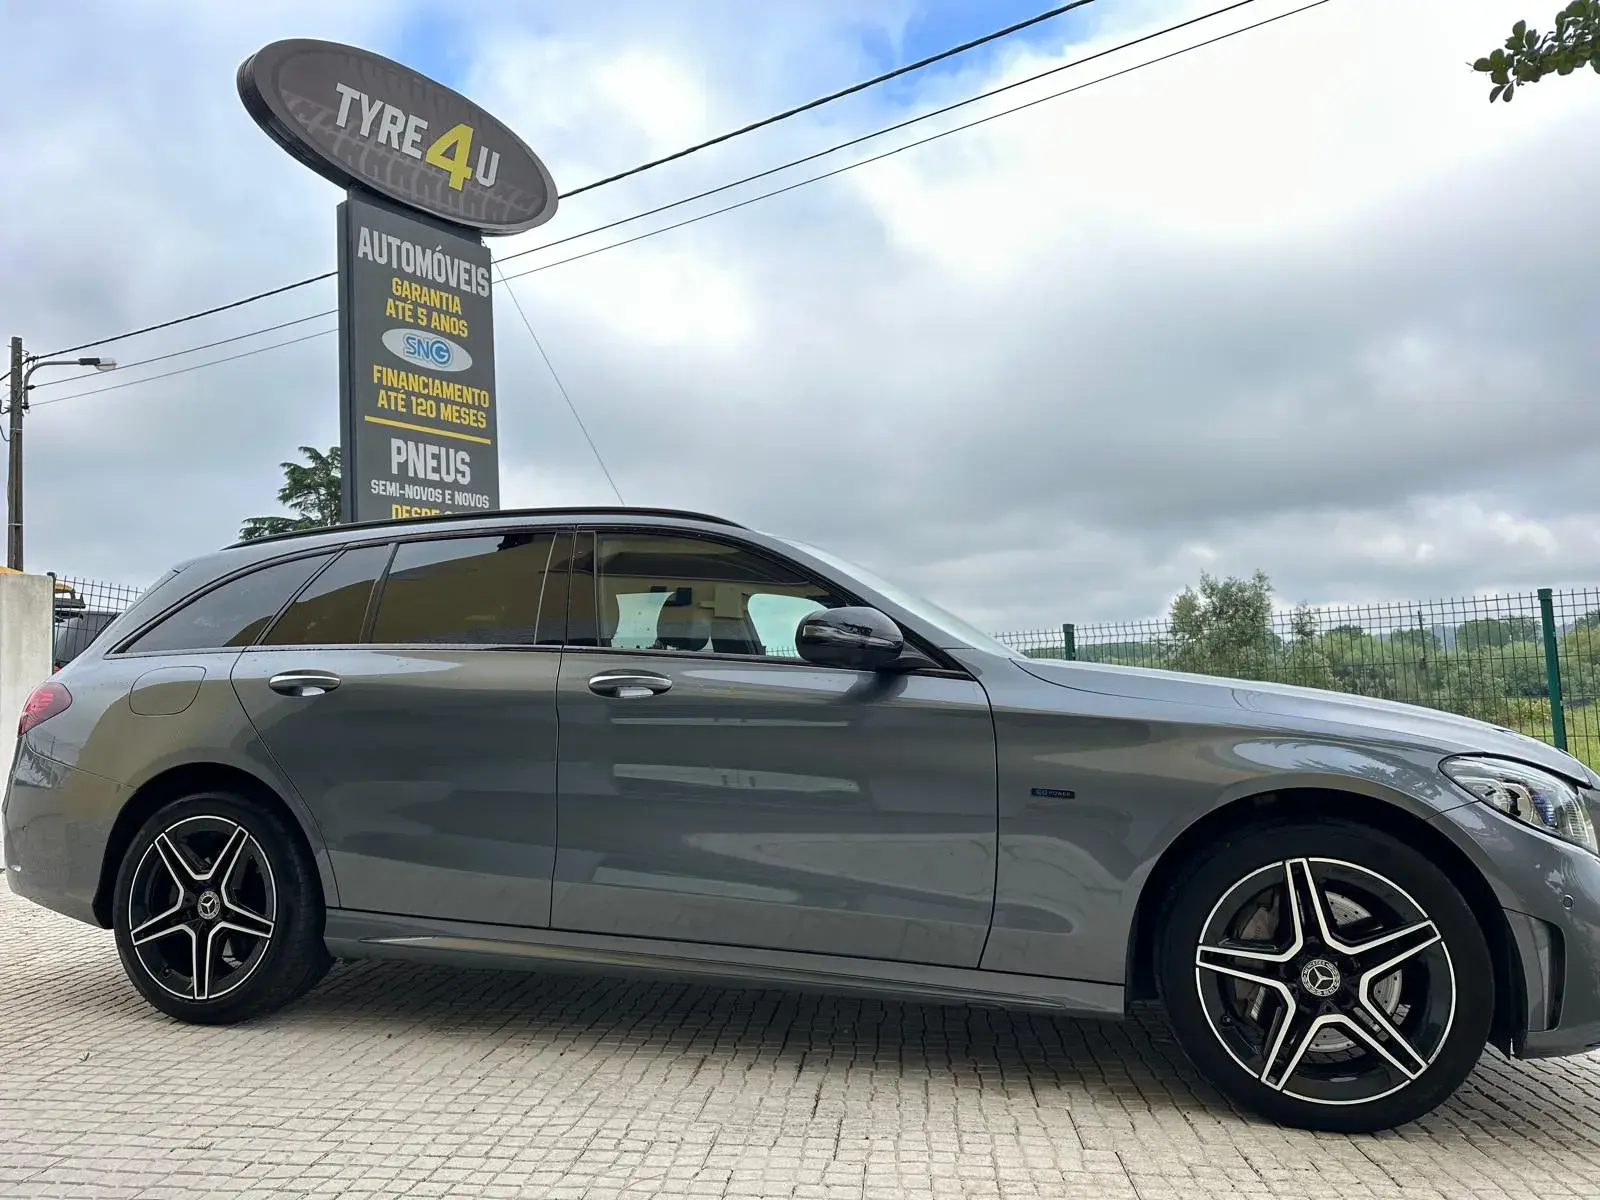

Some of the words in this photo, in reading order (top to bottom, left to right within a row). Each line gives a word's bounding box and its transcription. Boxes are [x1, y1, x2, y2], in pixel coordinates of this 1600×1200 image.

[357, 226, 490, 297] AUTOMÓVEIS
[391, 277, 462, 315] GARANTIA
[385, 298, 414, 323] ATÉ
[417, 307, 428, 326] 5
[430, 311, 468, 338] ANOS
[403, 333, 453, 368] SNG
[373, 364, 490, 408] FINANCIAMENTO
[377, 389, 406, 413] ATÉ
[411, 397, 436, 419] 120
[440, 402, 487, 429] MESES
[390, 437, 471, 485] PNEUS
[370, 479, 443, 502] SEMI-NOVOS
[445, 489, 452, 504] E
[454, 491, 490, 509] NOVOS
